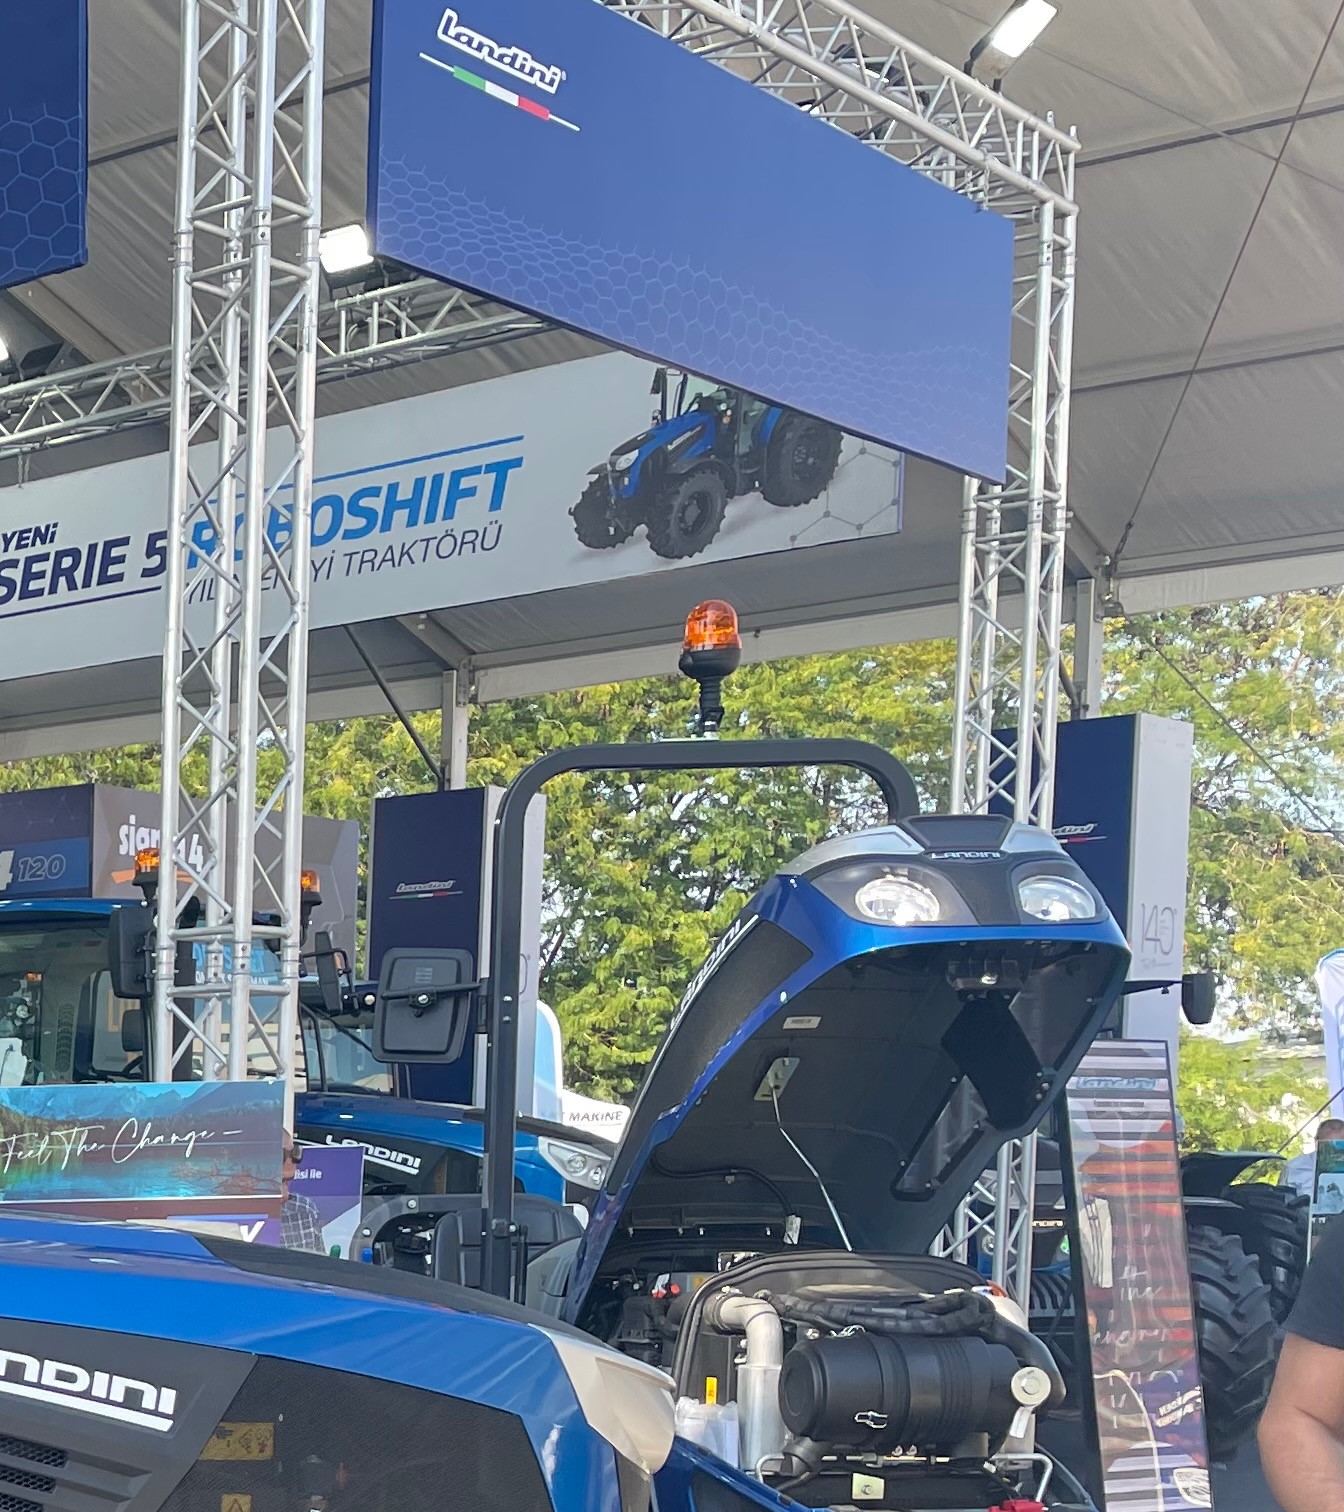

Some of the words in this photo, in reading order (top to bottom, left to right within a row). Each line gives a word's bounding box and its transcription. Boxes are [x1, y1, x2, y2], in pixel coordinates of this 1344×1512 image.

[436, 8, 563, 95] Landini
[1, 521, 60, 553] YENİ
[141, 530, 168, 578] 5
[186, 456, 525, 571] RBOSHIFT
[342, 519, 503, 577] TRAKTÖRÜ
[18, 854, 68, 882] 120
[930, 851, 1001, 860] LANDINI
[50, 1125, 106, 1171] The
[112, 1117, 215, 1164] Change
